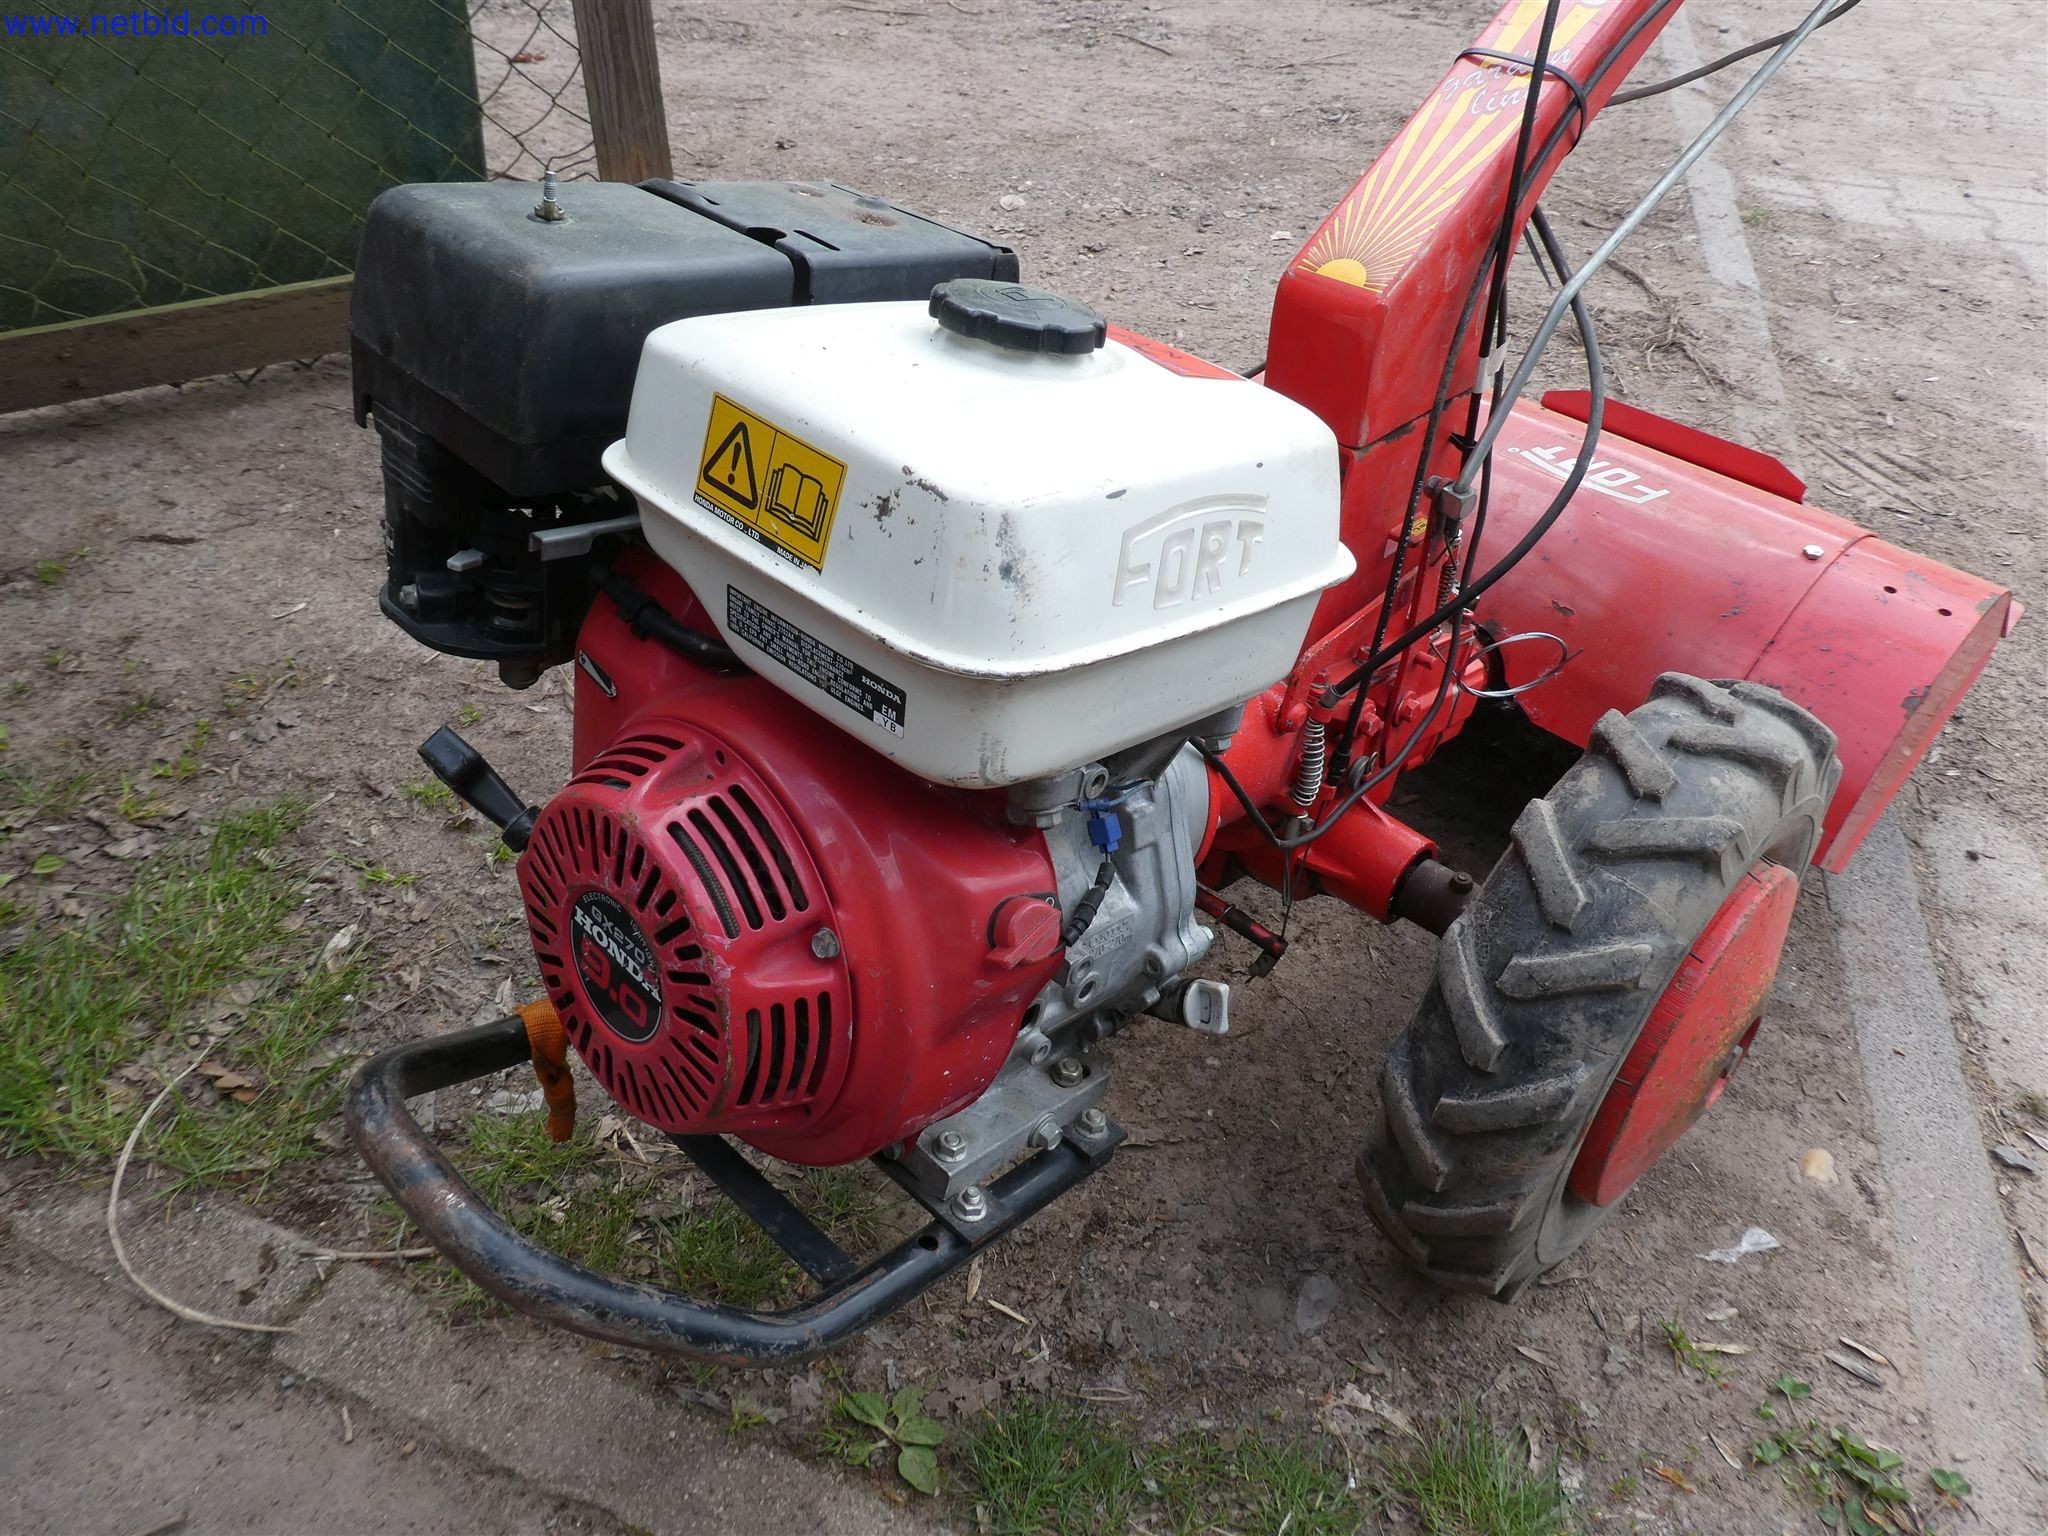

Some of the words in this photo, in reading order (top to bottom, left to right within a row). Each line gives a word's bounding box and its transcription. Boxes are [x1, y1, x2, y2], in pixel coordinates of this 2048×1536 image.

[1443, 48, 1572, 101] gardn
[1472, 87, 1527, 115] lin
[694, 494, 714, 511] HONDA
[714, 506, 735, 525] MOTOR
[776, 547, 793, 562] MADE
[1112, 493, 1269, 610] FORT
[729, 594, 742, 607] ENGINE
[730, 607, 760, 632] SPECIFICATIONS
[762, 628, 770, 639] AND
[819, 664, 834, 679] ENGINE
[837, 676, 862, 696] CONFORMS
[865, 692, 871, 702] TO
[741, 628, 764, 648] CALIFORNIA
[766, 645, 785, 662] EMISSION
[788, 659, 816, 682] REGULATIONS
[782, 635, 799, 650] MANUAL
[802, 647, 810, 657] FOR
[813, 654, 843, 678] MAINTENANCE
[818, 643, 833, 658] MOTOR
[770, 640, 783, 654] SMALL
[786, 650, 809, 670] NON-ROAD
[830, 678, 860, 702] REGULATIONS
[863, 698, 872, 710] AND
[861, 673, 901, 705] HONDA
[881, 703, 896, 722] EM
[583, 892, 622, 912] ELECTRONIC
[591, 905, 645, 964] GX270
[574, 905, 661, 1002] HONDA
